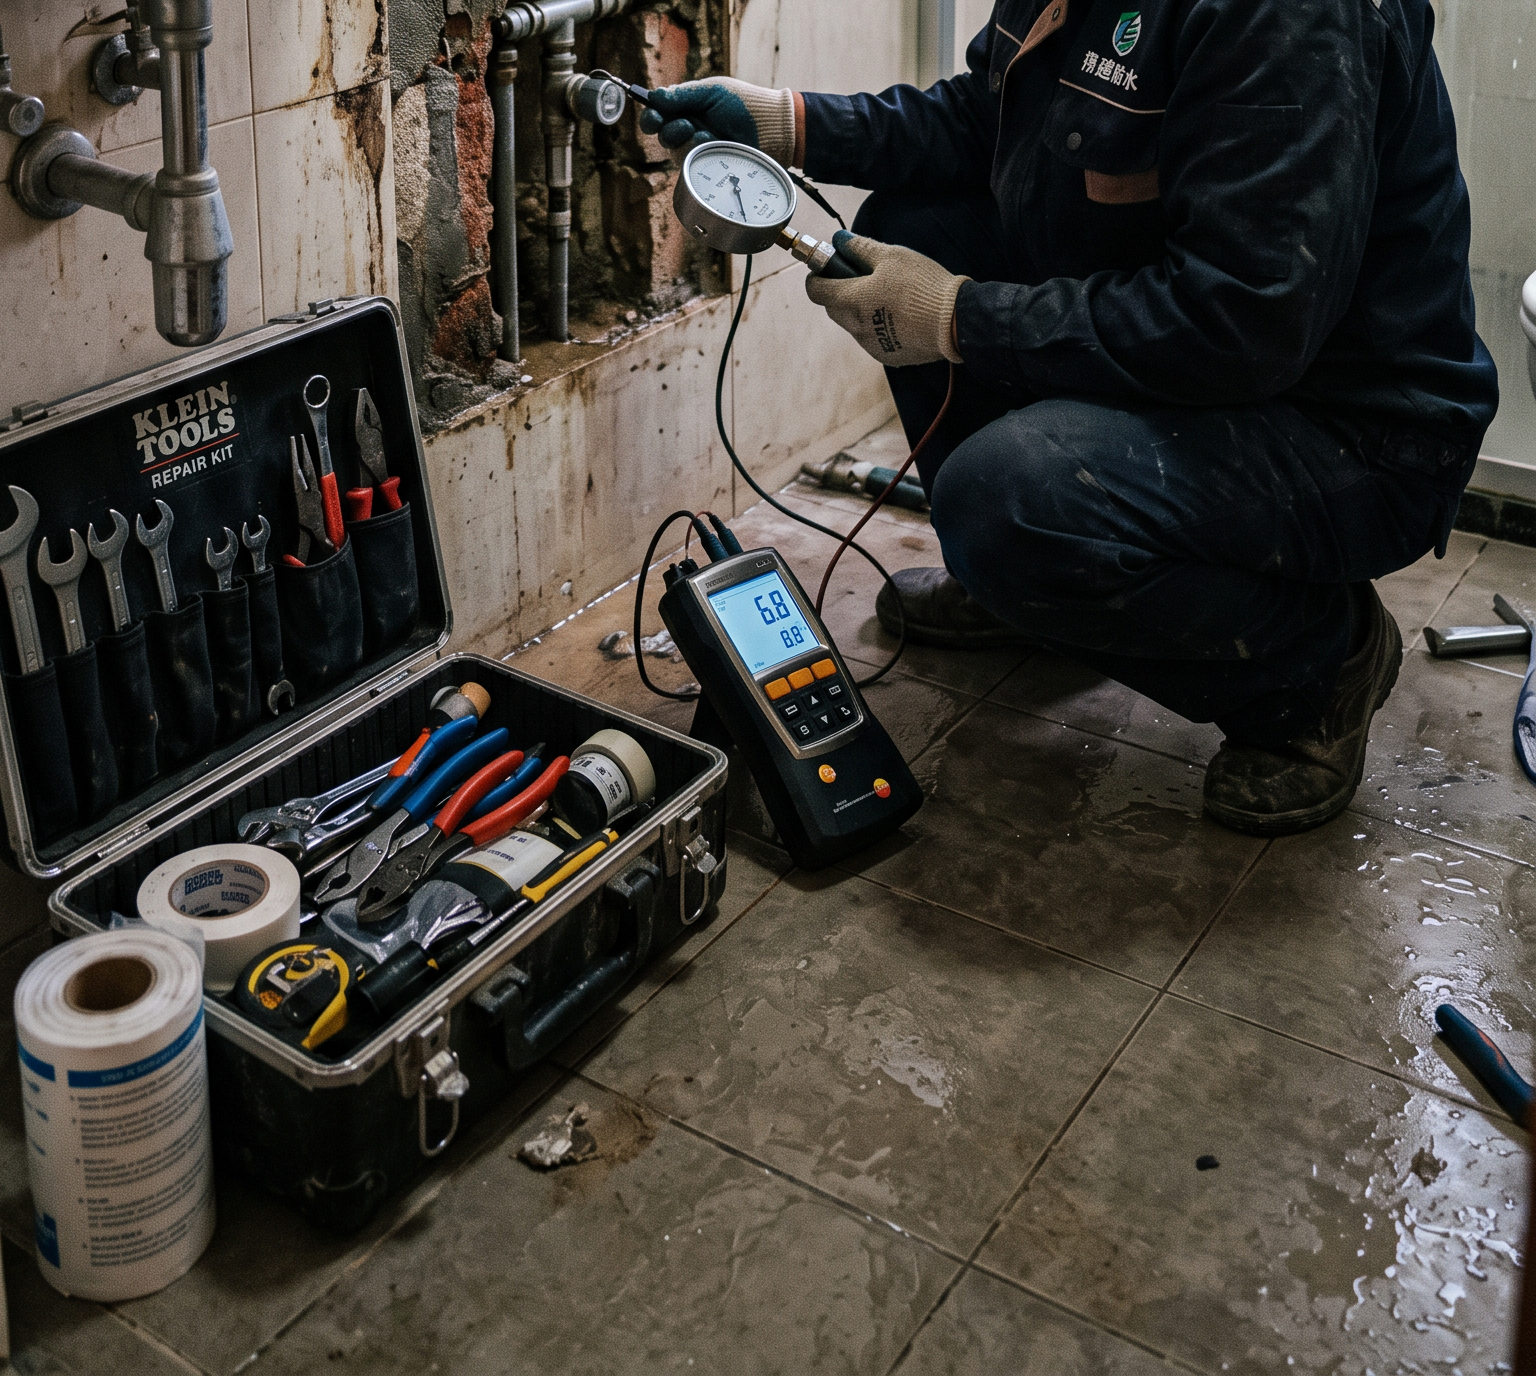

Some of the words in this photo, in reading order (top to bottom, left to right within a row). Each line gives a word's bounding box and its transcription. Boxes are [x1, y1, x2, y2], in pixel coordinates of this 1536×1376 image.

[132, 380, 230, 439] KLEIN
[136, 407, 236, 464] TOOLS
[151, 455, 207, 489] REPAIR
[211, 443, 234, 466] KIT
[754, 590, 791, 626] 6.8
[780, 625, 805, 649] 8.8
